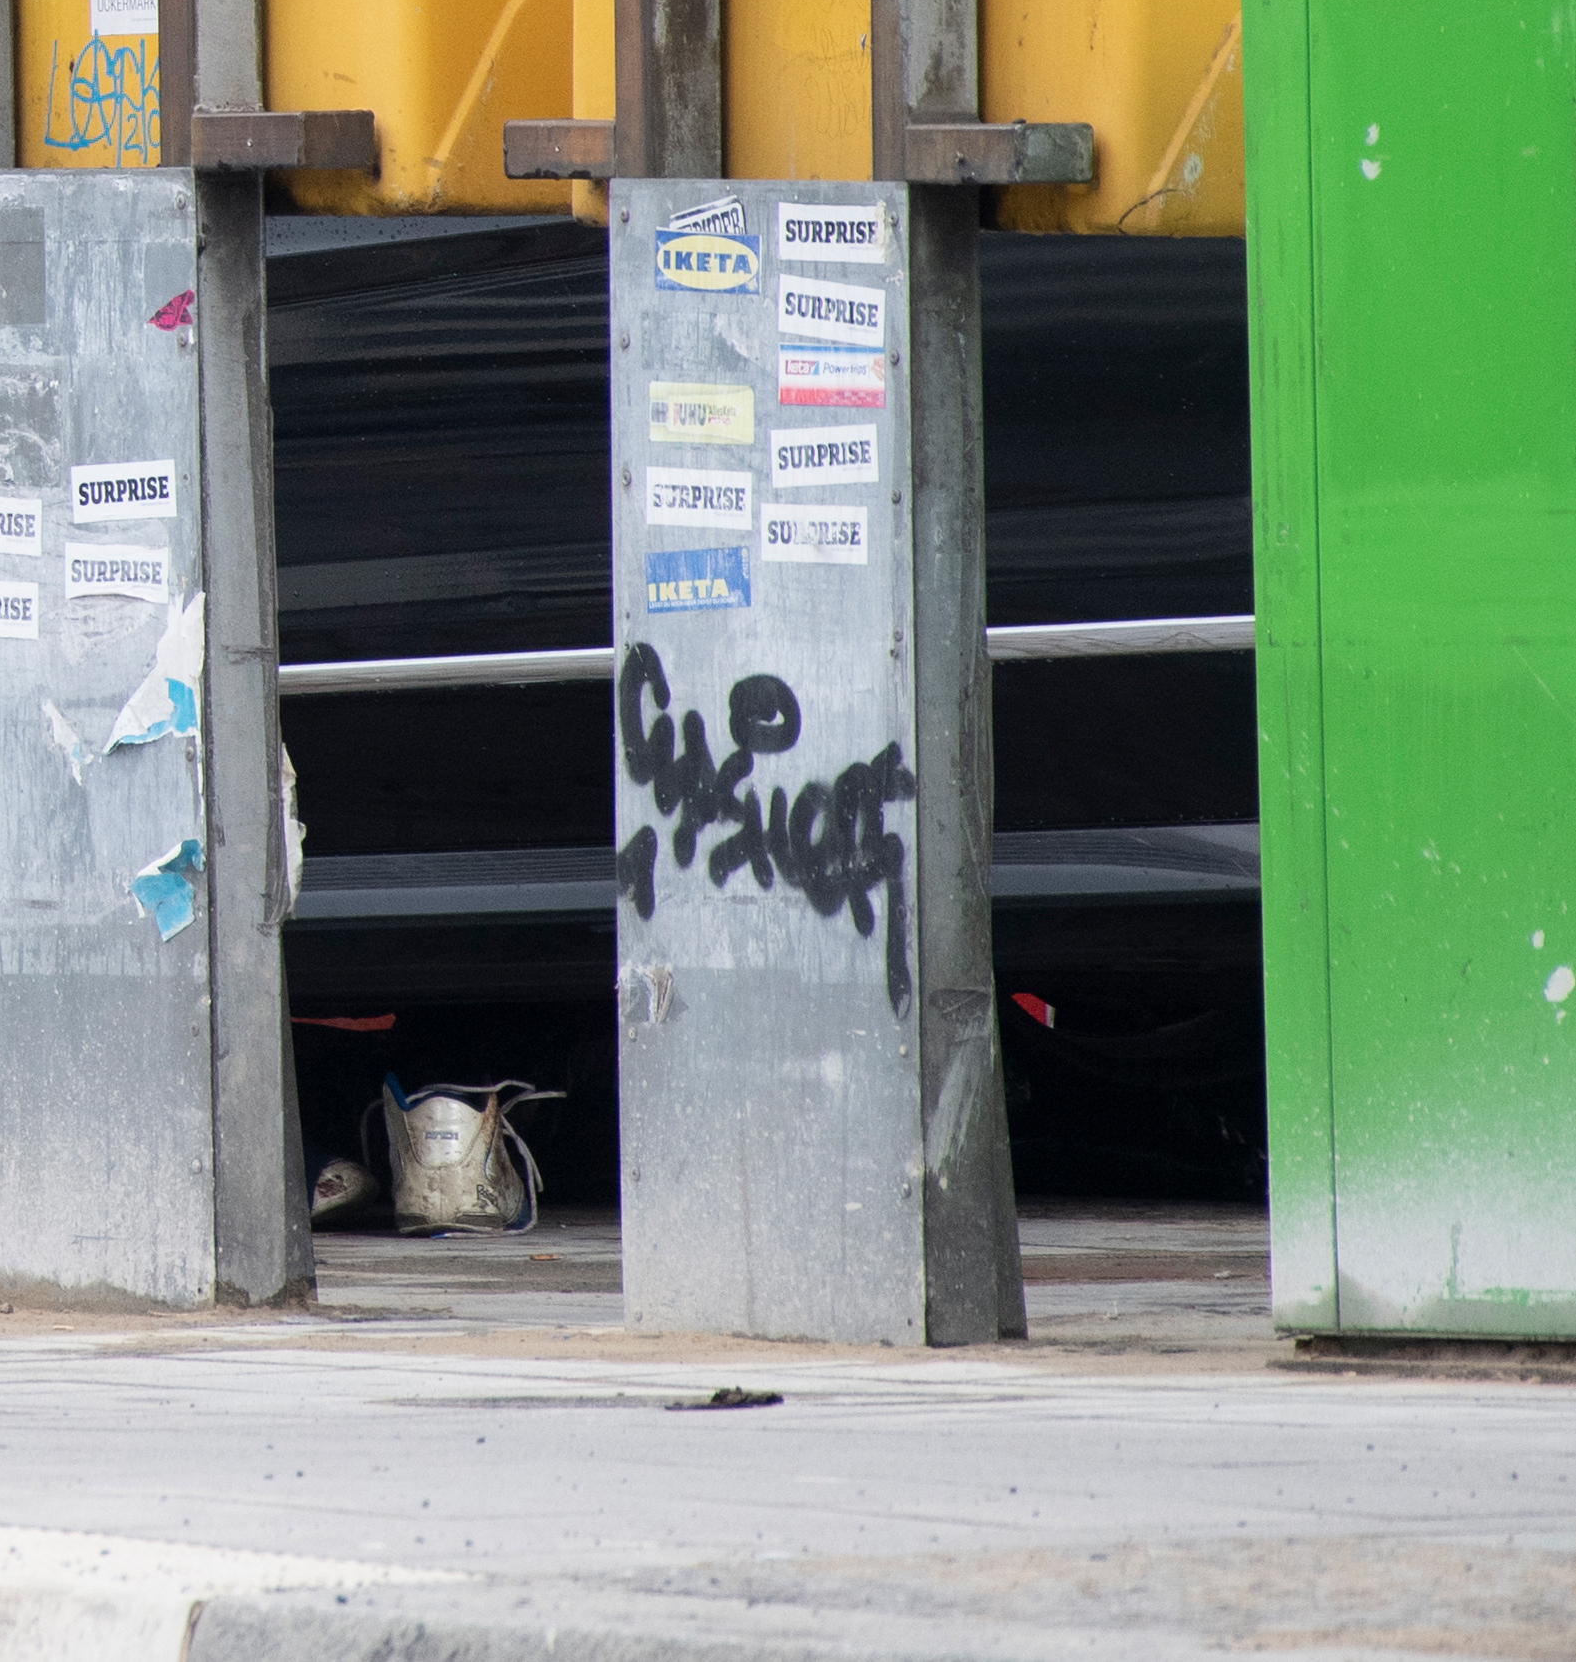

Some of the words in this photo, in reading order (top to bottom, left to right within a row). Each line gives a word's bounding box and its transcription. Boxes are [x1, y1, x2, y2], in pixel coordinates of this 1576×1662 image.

[785, 219, 877, 244] SURPRISE
[663, 250, 752, 274] IKETA
[785, 291, 878, 328] SURPRISE
[778, 440, 872, 471] SURPRISE
[79, 475, 169, 506] SURPRISE
[653, 484, 746, 511] SURPRISE
[71, 559, 163, 585] SURPRISE
[648, 578, 730, 602] IKETA
